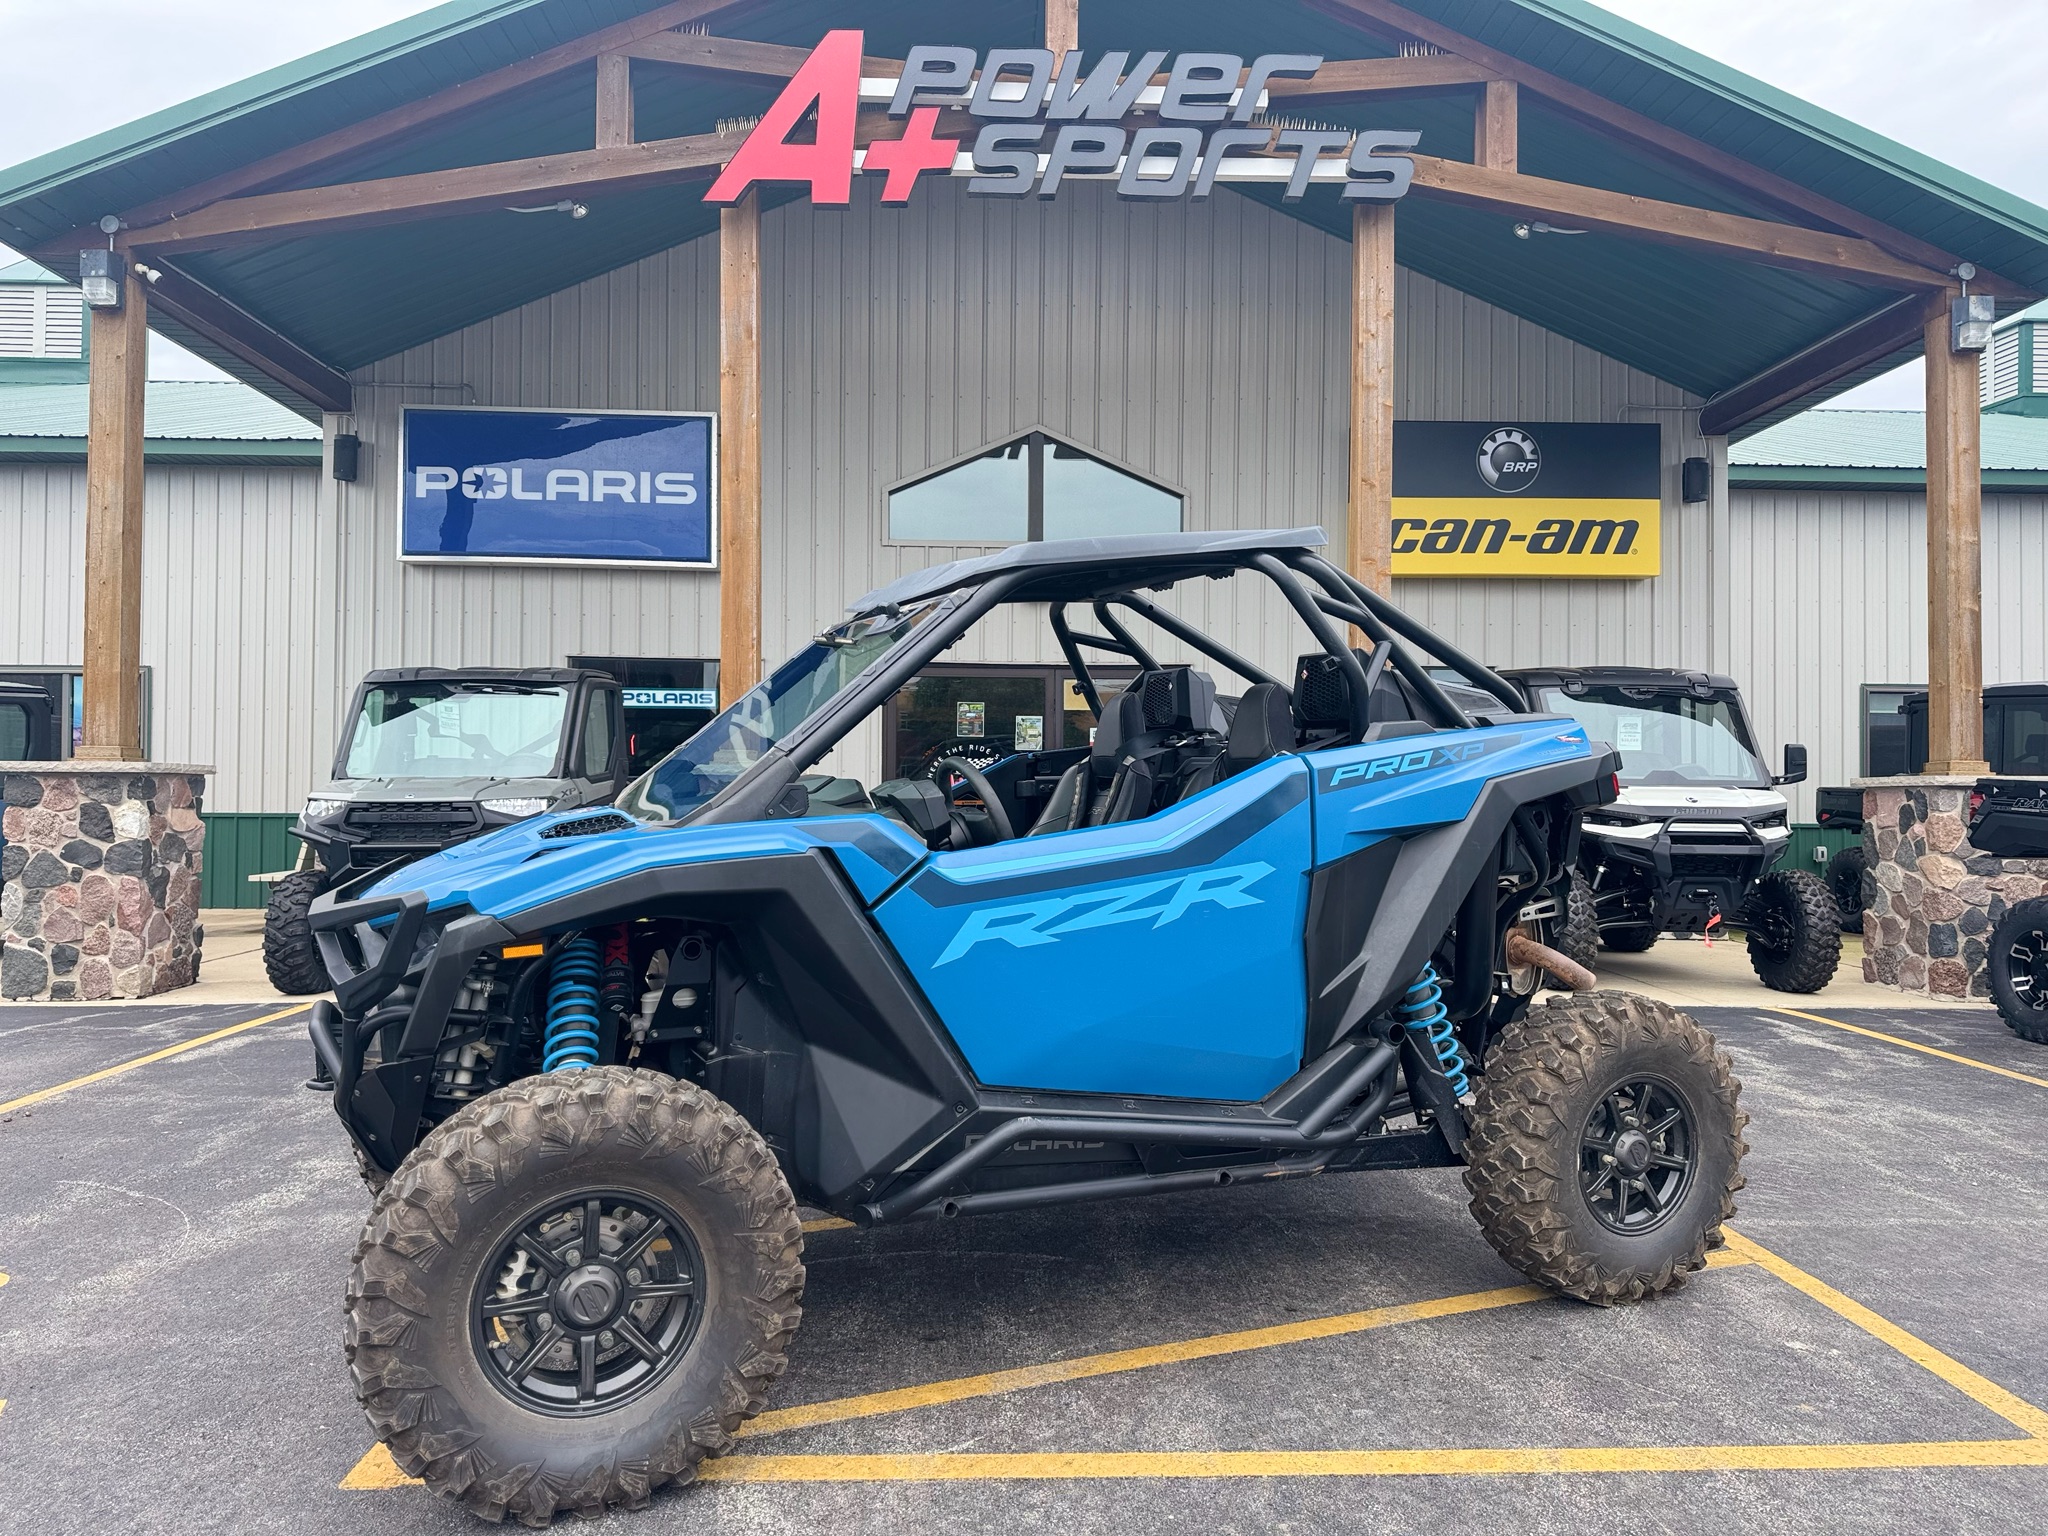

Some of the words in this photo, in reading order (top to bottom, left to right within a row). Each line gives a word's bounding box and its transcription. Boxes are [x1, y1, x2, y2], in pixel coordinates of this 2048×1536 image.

[701, 28, 961, 208] A+
[1502, 461, 1538, 473] BRP
[415, 466, 698, 505] POLARIS
[1391, 518, 1640, 555] can-am
[622, 692, 714, 705] POLARIS
[927, 755, 944, 779] HERE
[945, 744, 964, 756] THE
[968, 743, 992, 755] RIDE
[1329, 749, 1434, 787] PRO
[1433, 742, 1486, 766] XP
[560, 787, 577, 799] XP
[380, 813, 438, 822] POLARIS
[930, 860, 1277, 970] RZR
